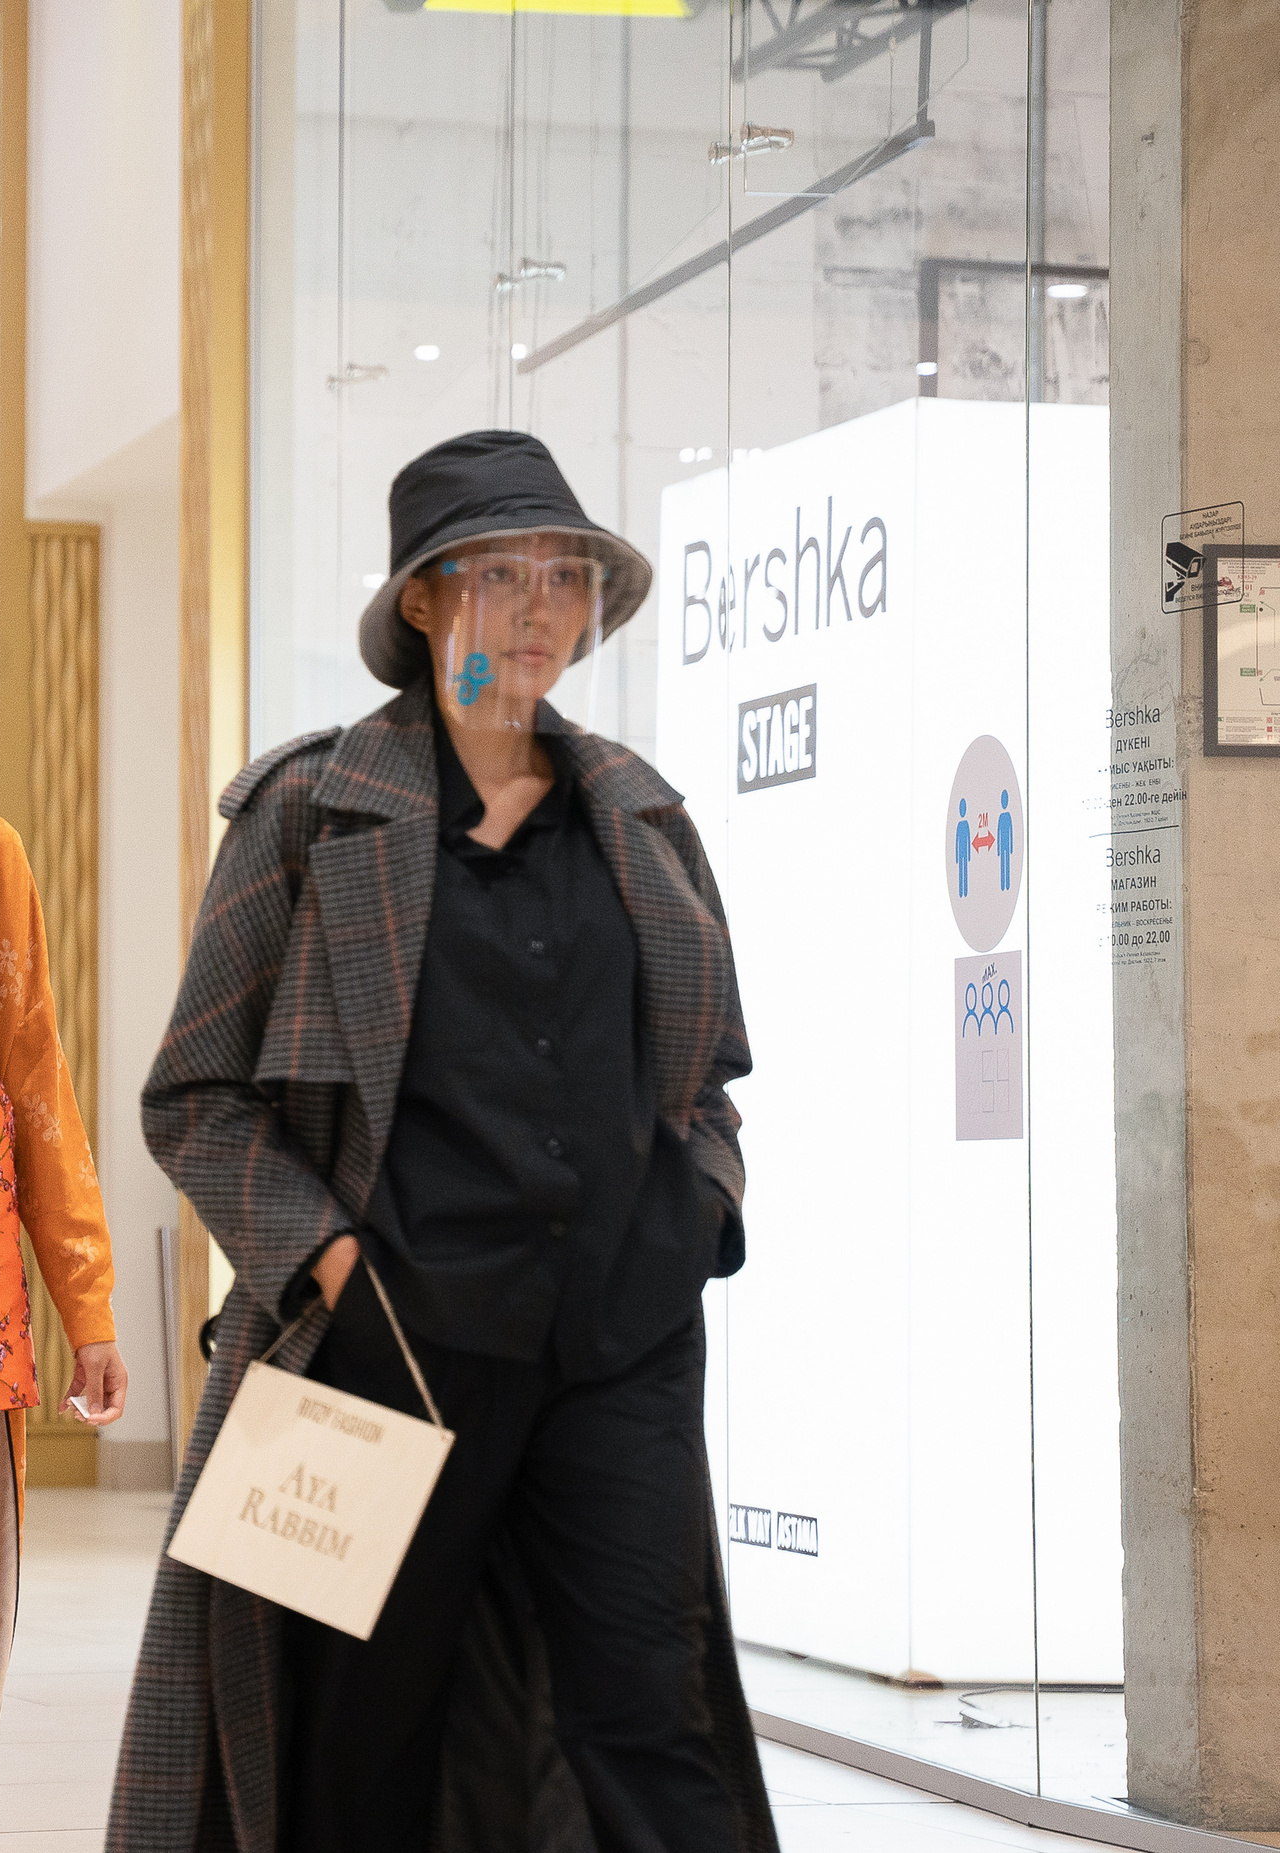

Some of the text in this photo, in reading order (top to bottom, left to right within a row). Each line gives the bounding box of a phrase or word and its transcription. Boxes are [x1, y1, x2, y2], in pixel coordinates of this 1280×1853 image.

[683, 496, 887, 666] Bershka
[1105, 704, 1161, 729] Bershka
[741, 695, 813, 783] STAGE
[1162, 788, 1188, 804] дейін
[1105, 845, 1161, 868] Bershka
[1111, 876, 1157, 891] МАГАЗИН
[1131, 898, 1173, 912] РАБОТЫ:
[1106, 932, 1130, 947] 0.00
[1131, 934, 1144, 947] до
[1146, 930, 1170, 944] 22.00
[277, 1462, 340, 1514] AYA
[239, 1485, 355, 1562] RABBIM
